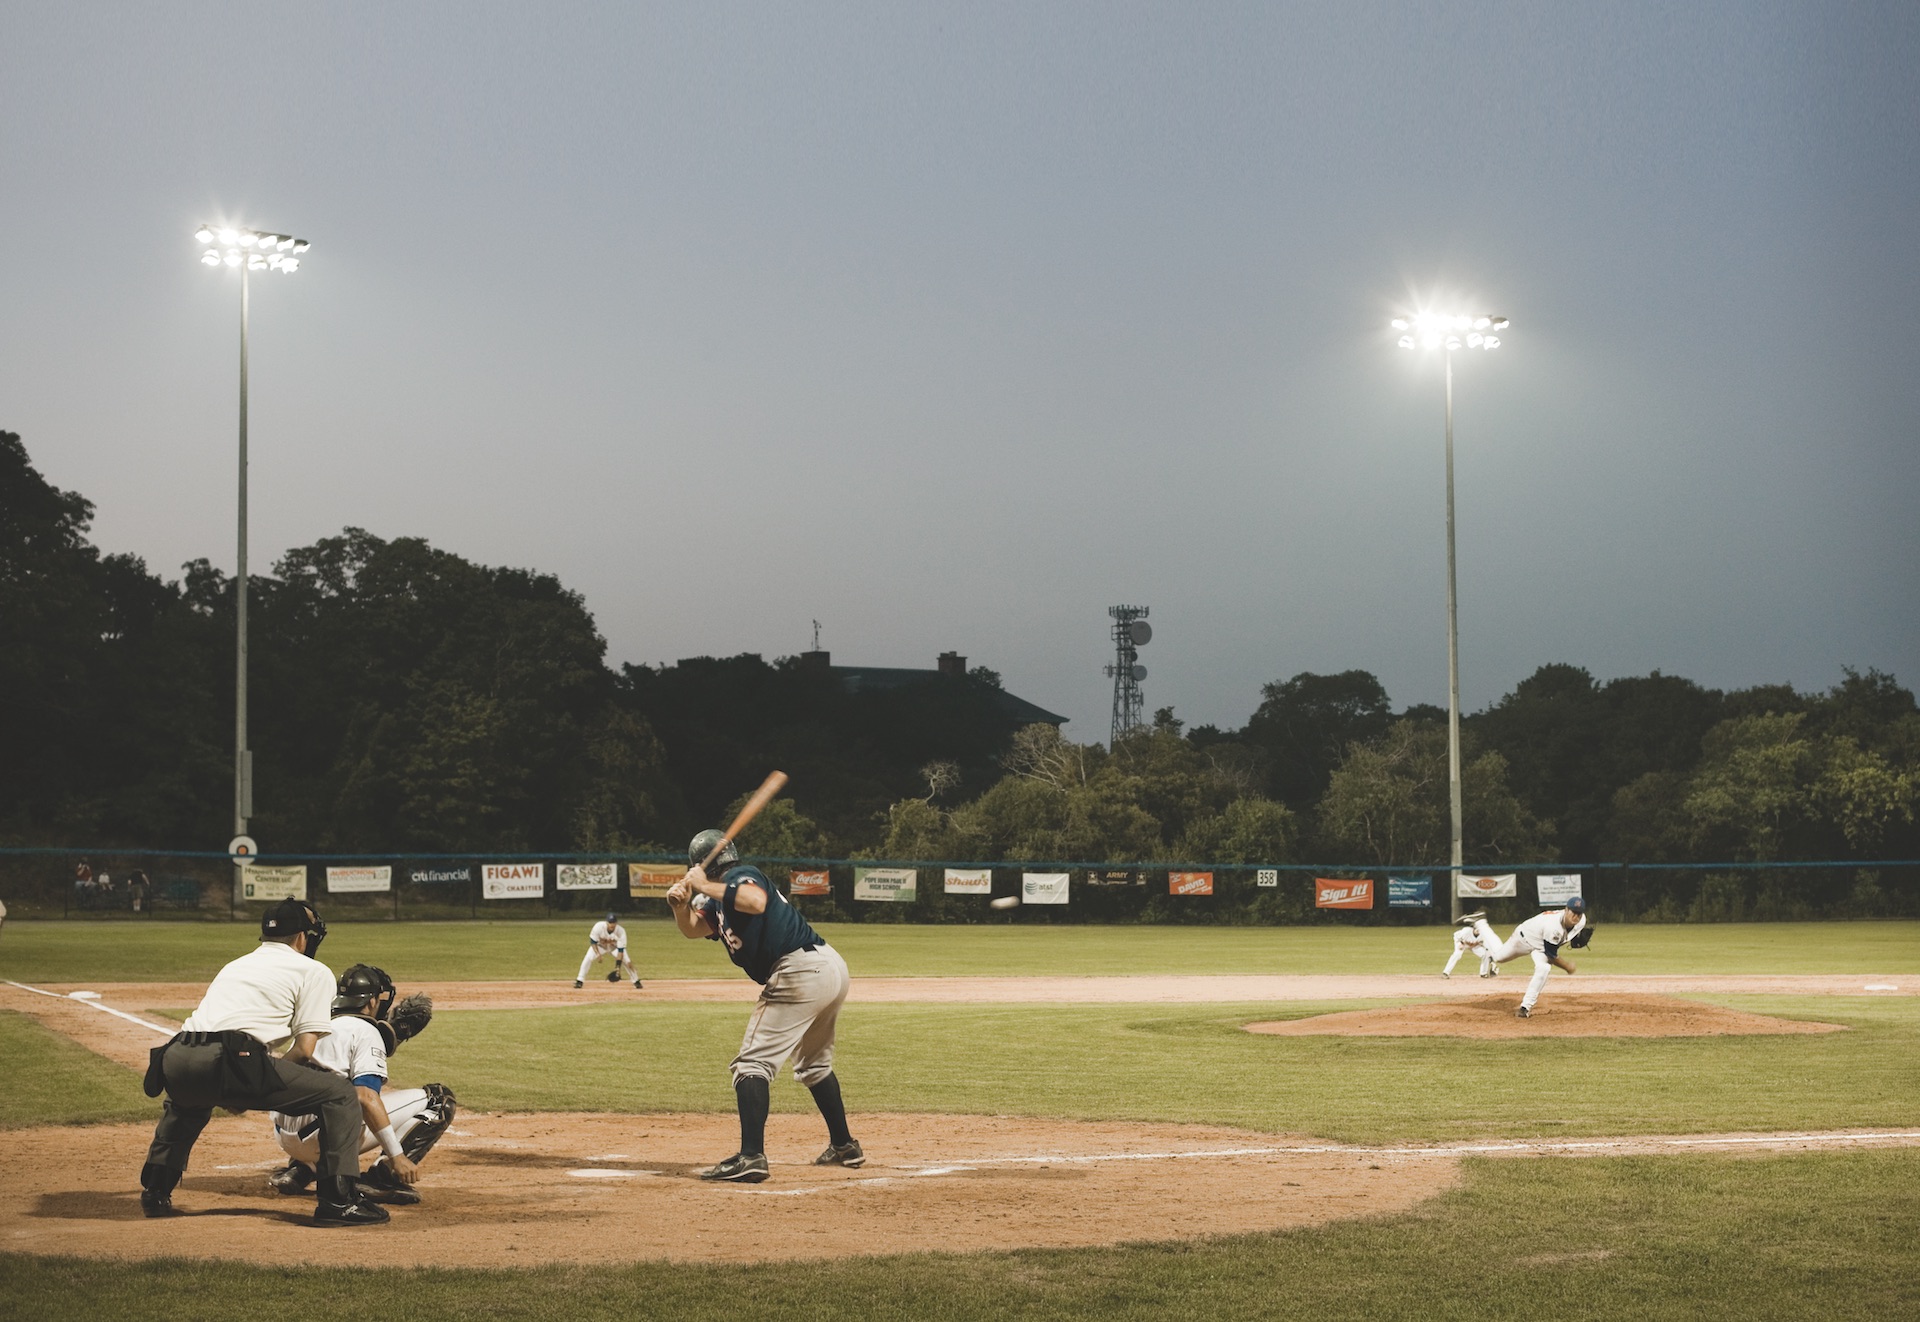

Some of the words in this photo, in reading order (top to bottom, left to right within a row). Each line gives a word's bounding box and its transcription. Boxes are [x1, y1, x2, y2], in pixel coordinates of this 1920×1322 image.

[487, 865, 539, 879] FIGAWI
[1106, 871, 1128, 879] ARMY
[1177, 878, 1206, 894] DAVID
[1319, 888, 1349, 902] Sign
[1350, 883, 1368, 897] It!
